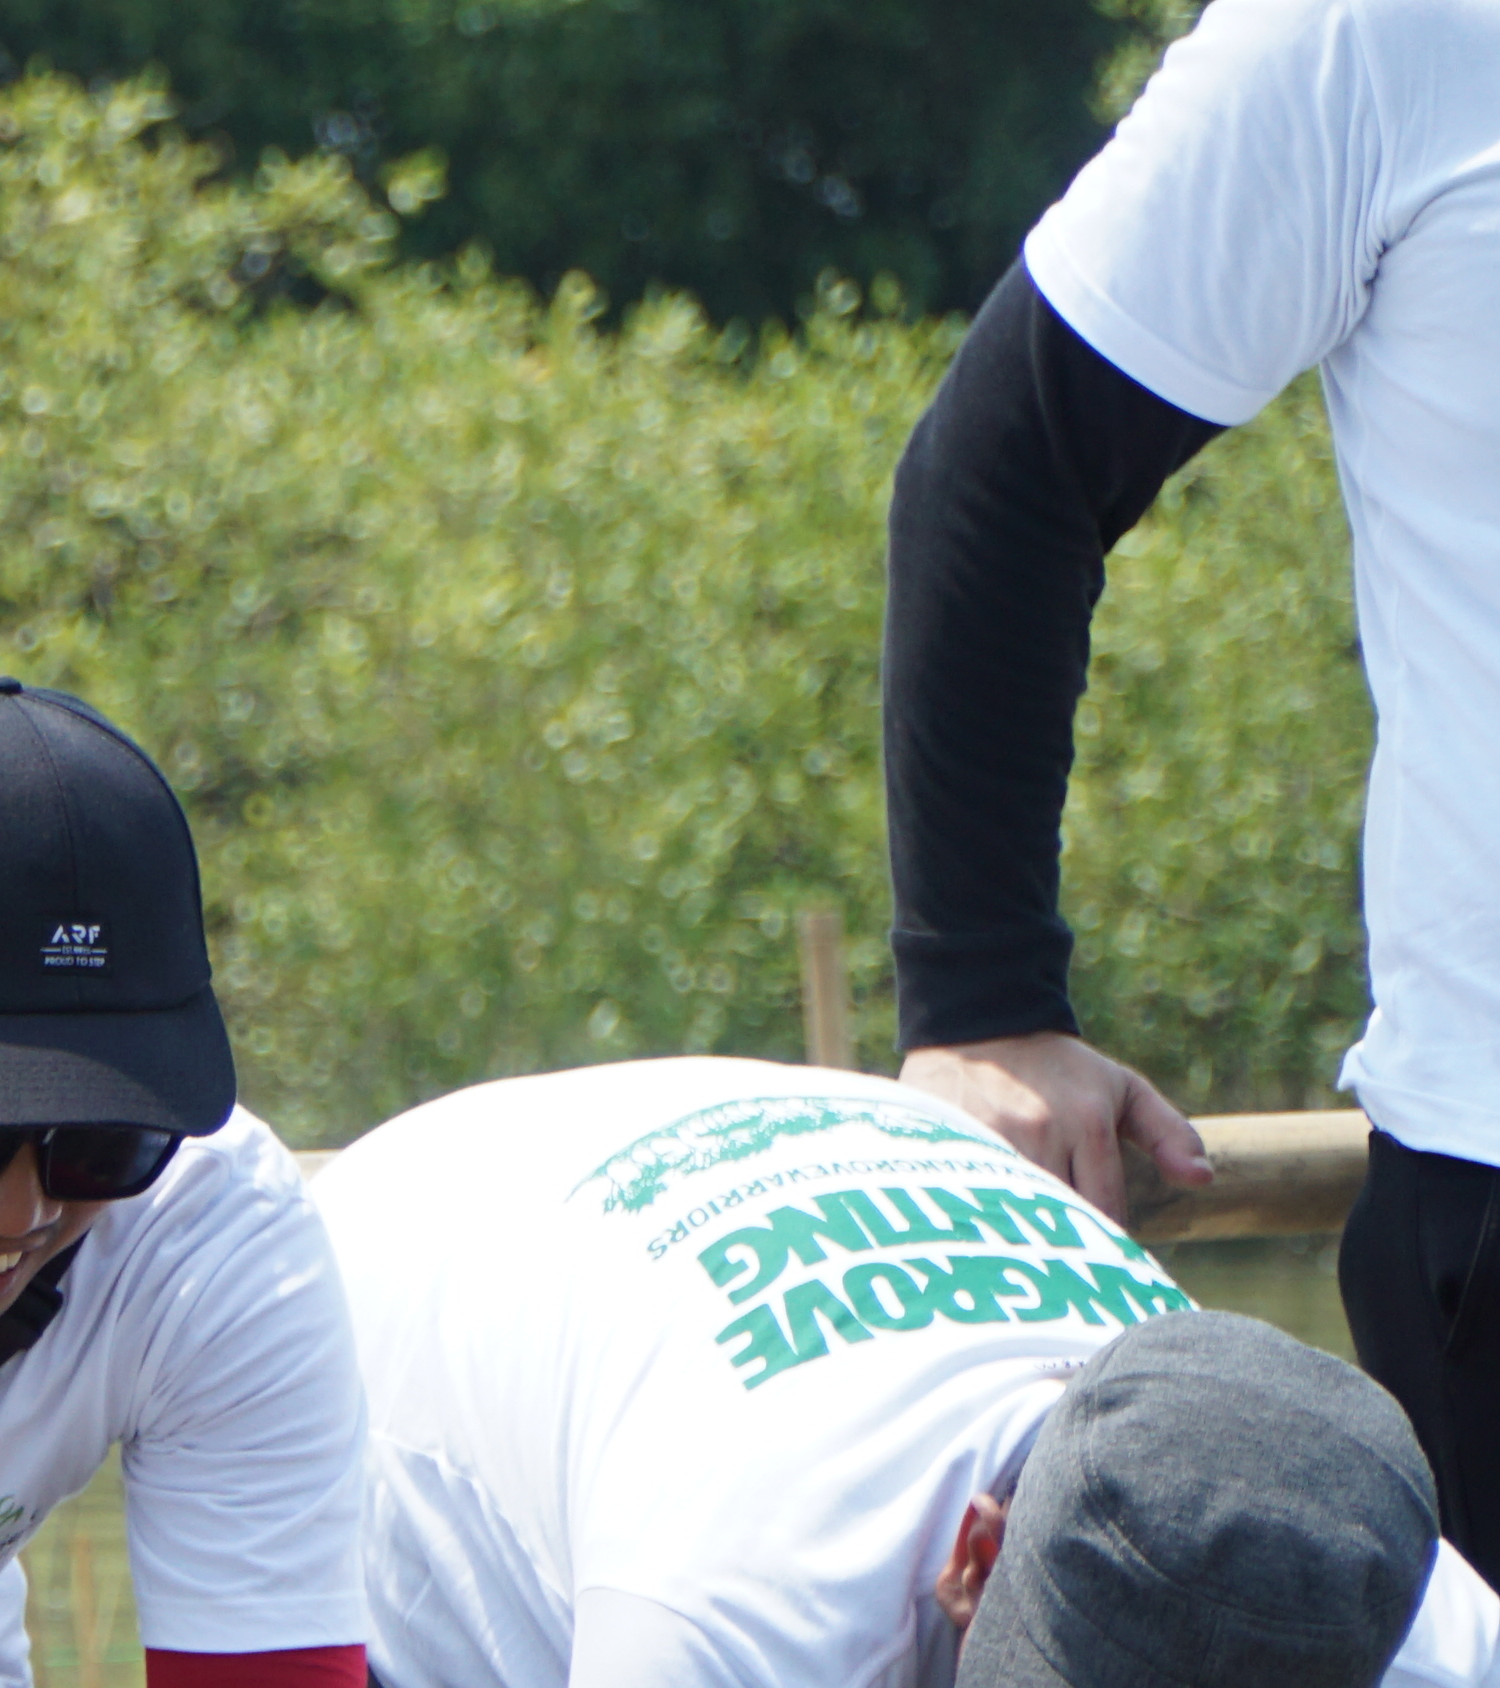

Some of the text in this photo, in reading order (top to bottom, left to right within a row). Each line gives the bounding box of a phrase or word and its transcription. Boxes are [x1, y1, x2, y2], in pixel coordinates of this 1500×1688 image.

[51, 924, 101, 944] ARF
[696, 1187, 1110, 1306] ANTING
[714, 1256, 1194, 1391] ANGROVE
